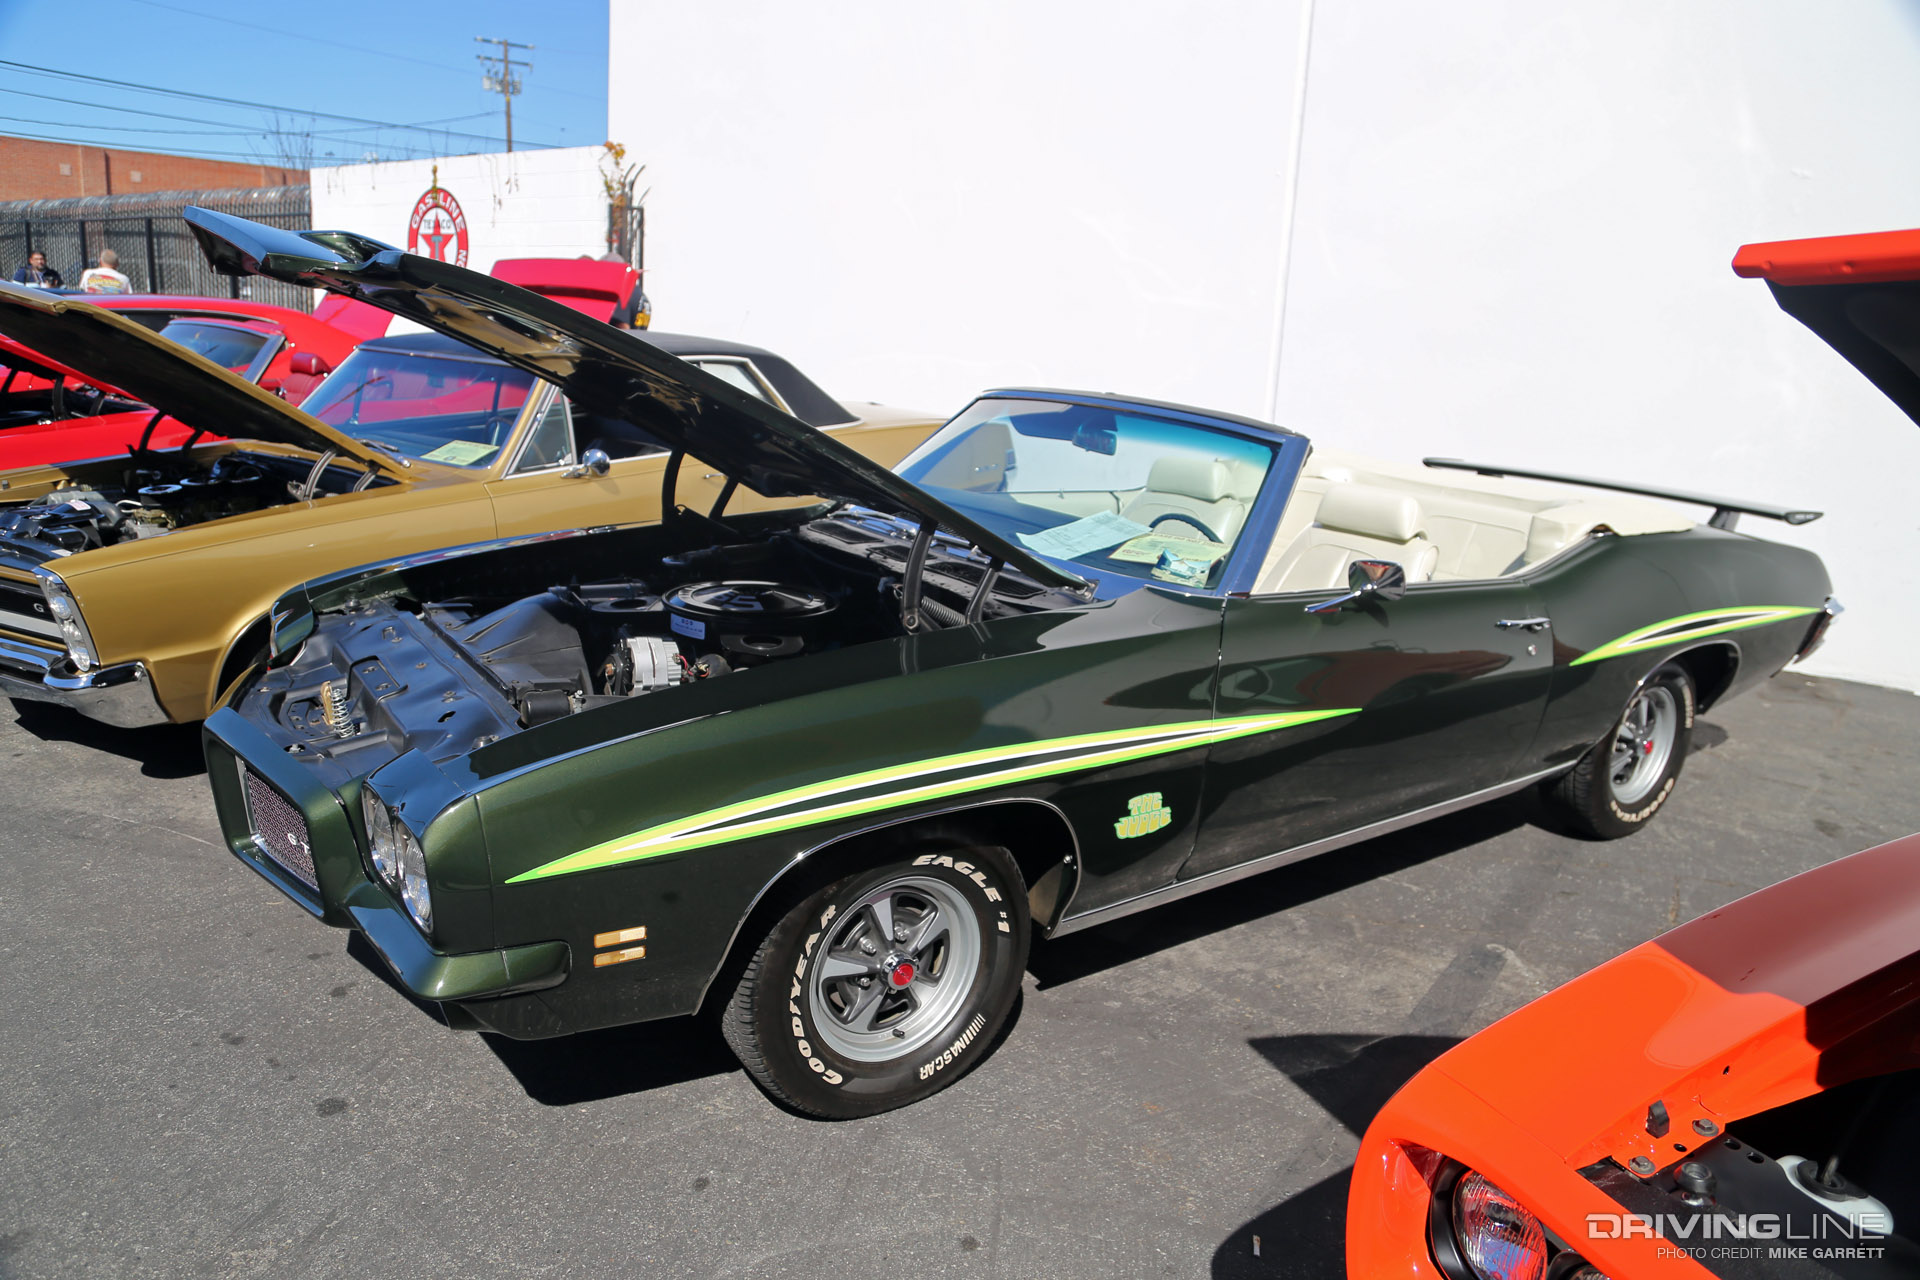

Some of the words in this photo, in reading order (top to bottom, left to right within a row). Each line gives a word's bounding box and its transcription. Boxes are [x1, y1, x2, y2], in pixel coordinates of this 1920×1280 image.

[411, 191, 466, 232] GASLINE
[423, 219, 452, 230] TECO
[1114, 807, 1172, 839] JUDGE
[912, 854, 1002, 903] EAGLE
[997, 911, 1010, 933] #1
[789, 904, 843, 1085] GOODYEAR
[919, 1037, 967, 1080] NASCAR
